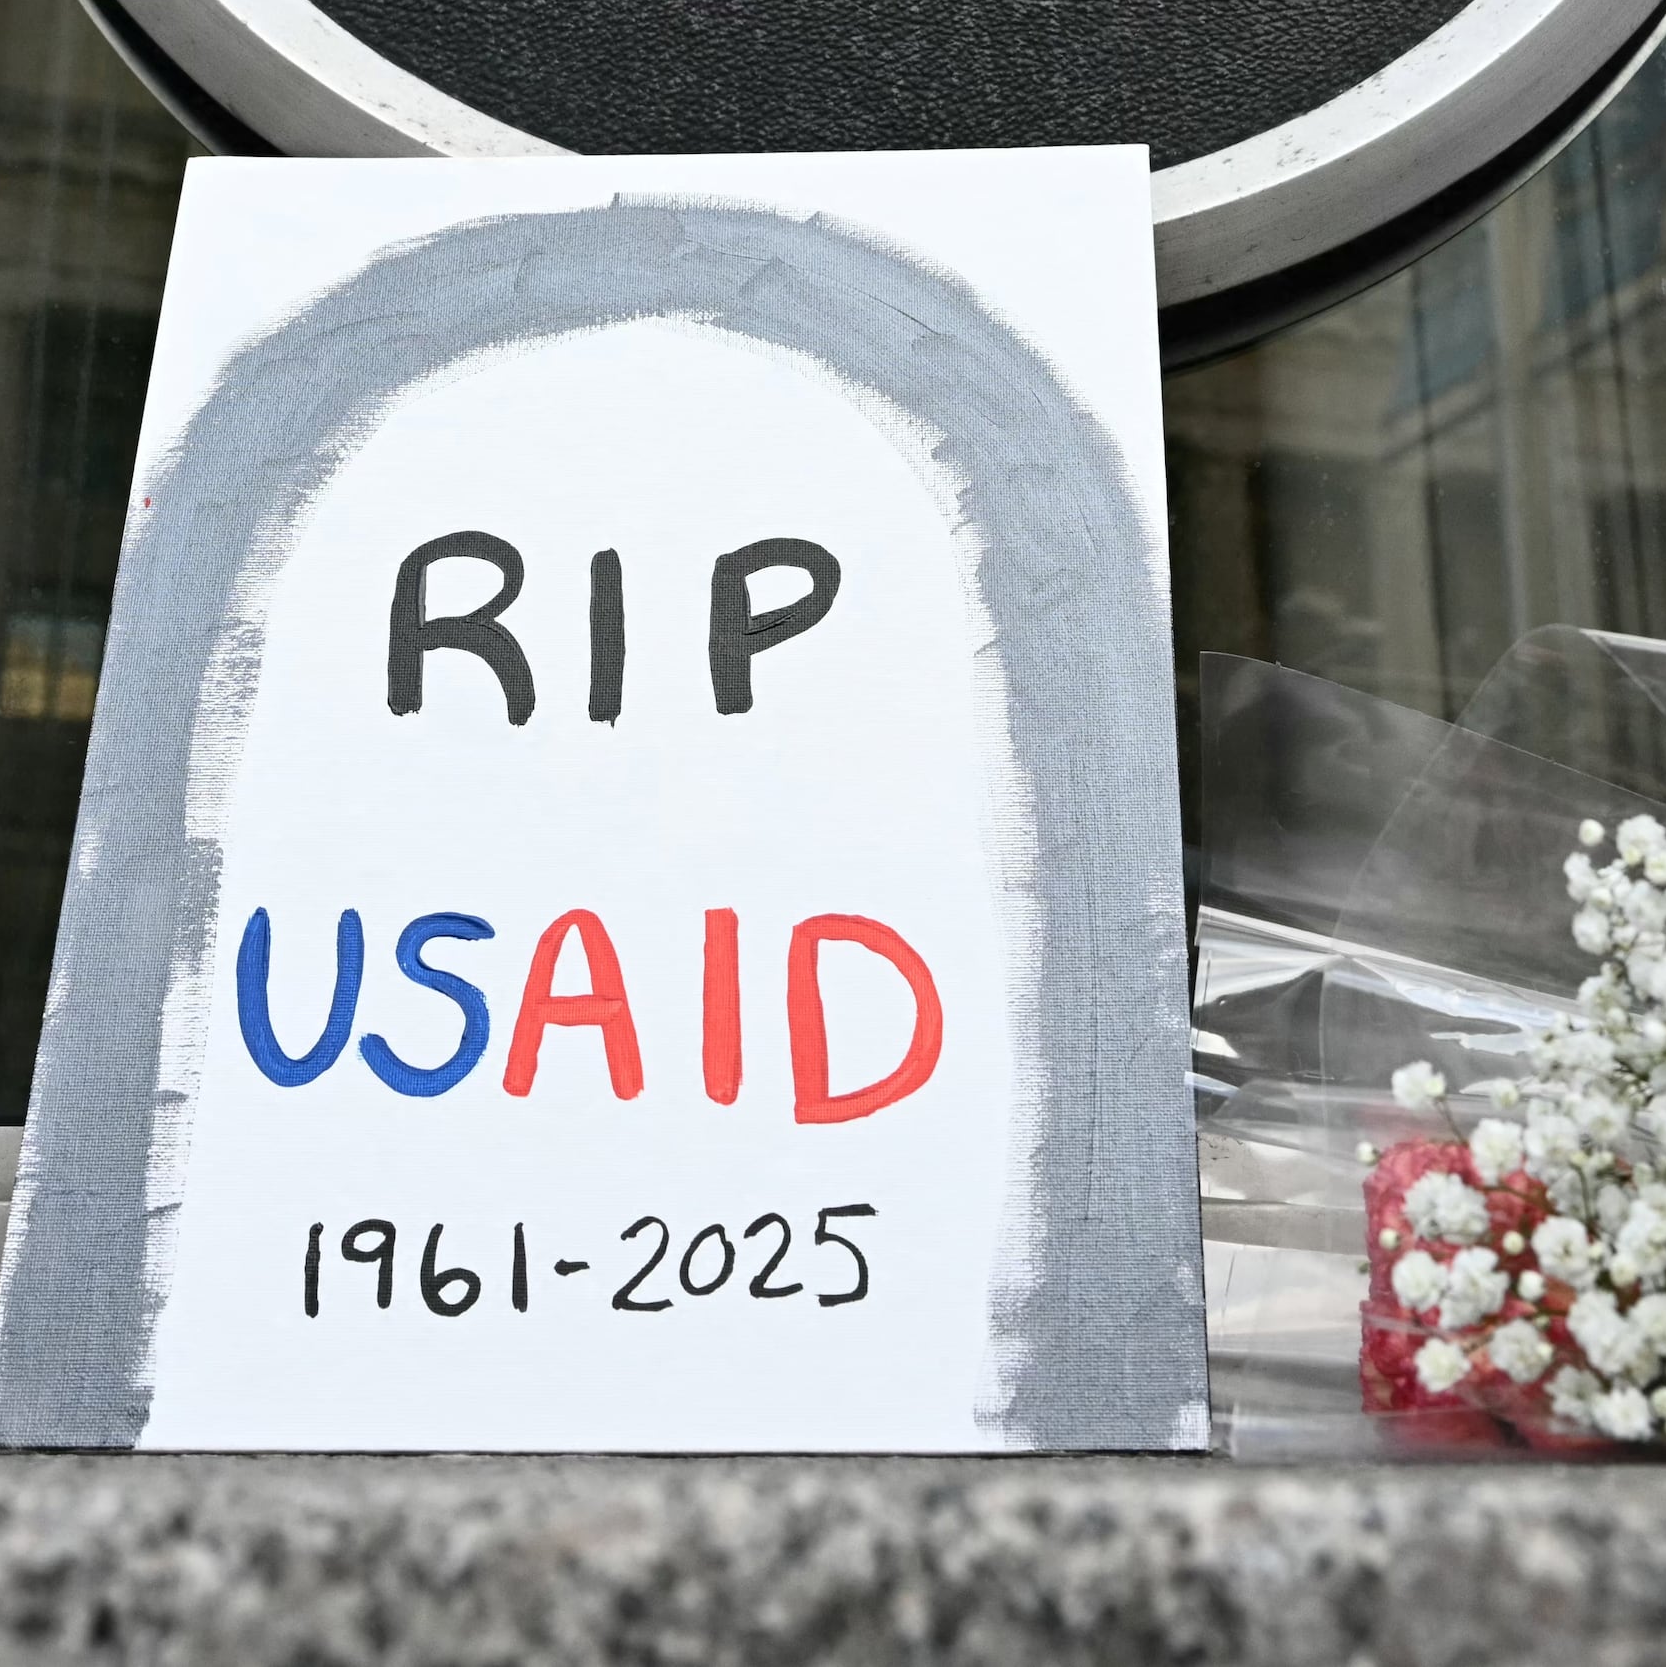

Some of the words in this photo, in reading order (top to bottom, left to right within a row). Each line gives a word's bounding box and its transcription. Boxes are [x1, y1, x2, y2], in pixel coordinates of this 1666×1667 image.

[387, 530, 841, 728] RIP
[236, 906, 943, 1125] USAID
[304, 1203, 877, 1319] 1961-2025
